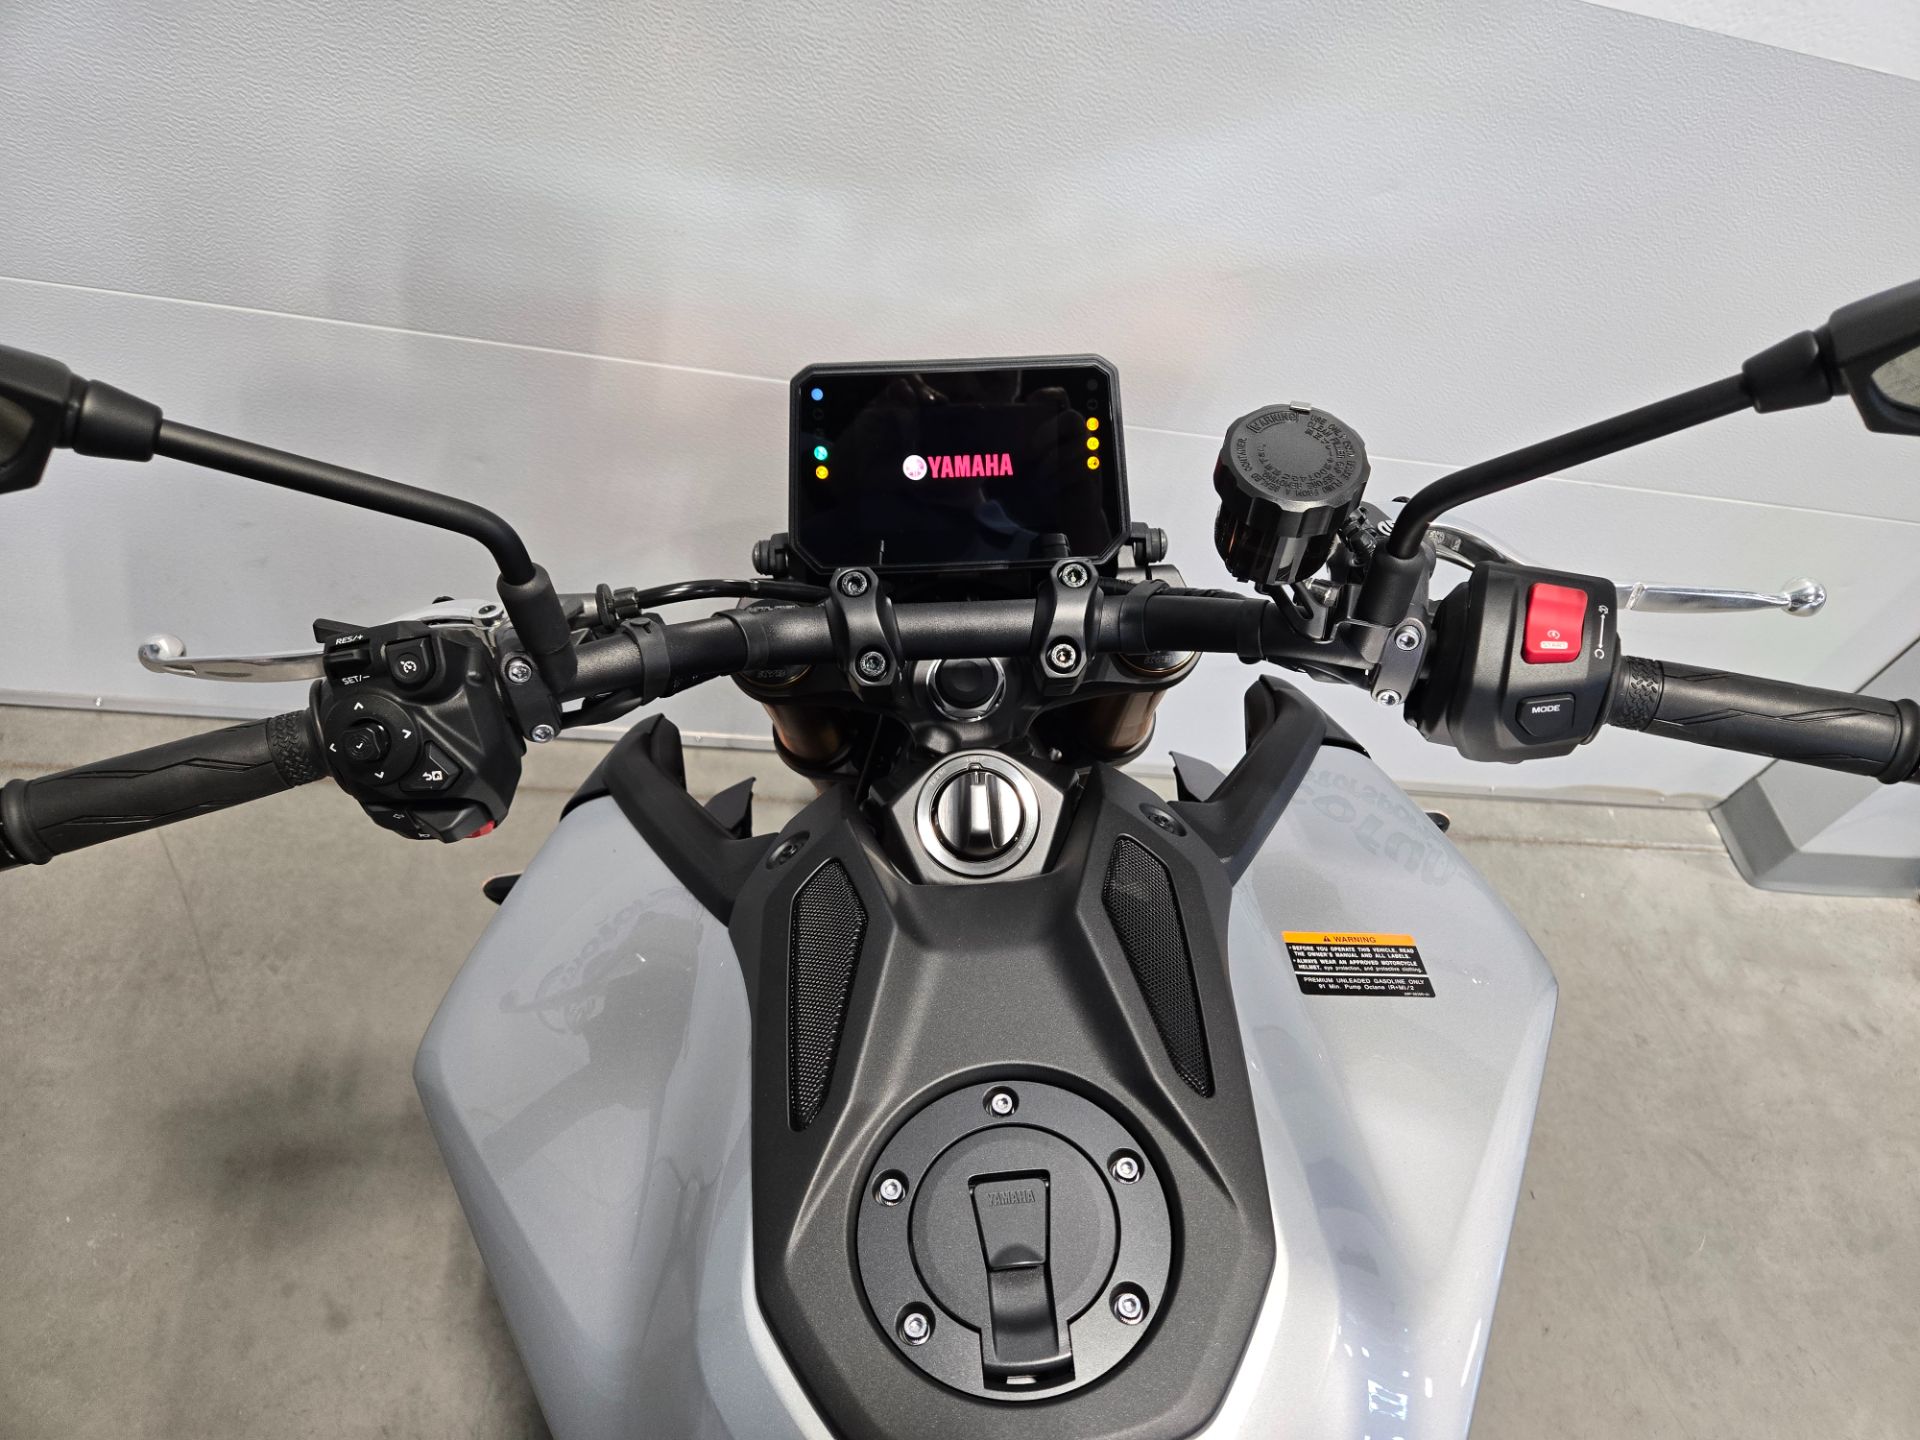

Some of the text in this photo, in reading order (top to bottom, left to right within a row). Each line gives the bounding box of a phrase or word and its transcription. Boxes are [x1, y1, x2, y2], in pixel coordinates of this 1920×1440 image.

[927, 452, 1014, 479] YAMAHA
[335, 634, 364, 645] RES/+
[1531, 704, 1561, 714] MODE
[986, 1188, 1036, 1207] YAMAHA
